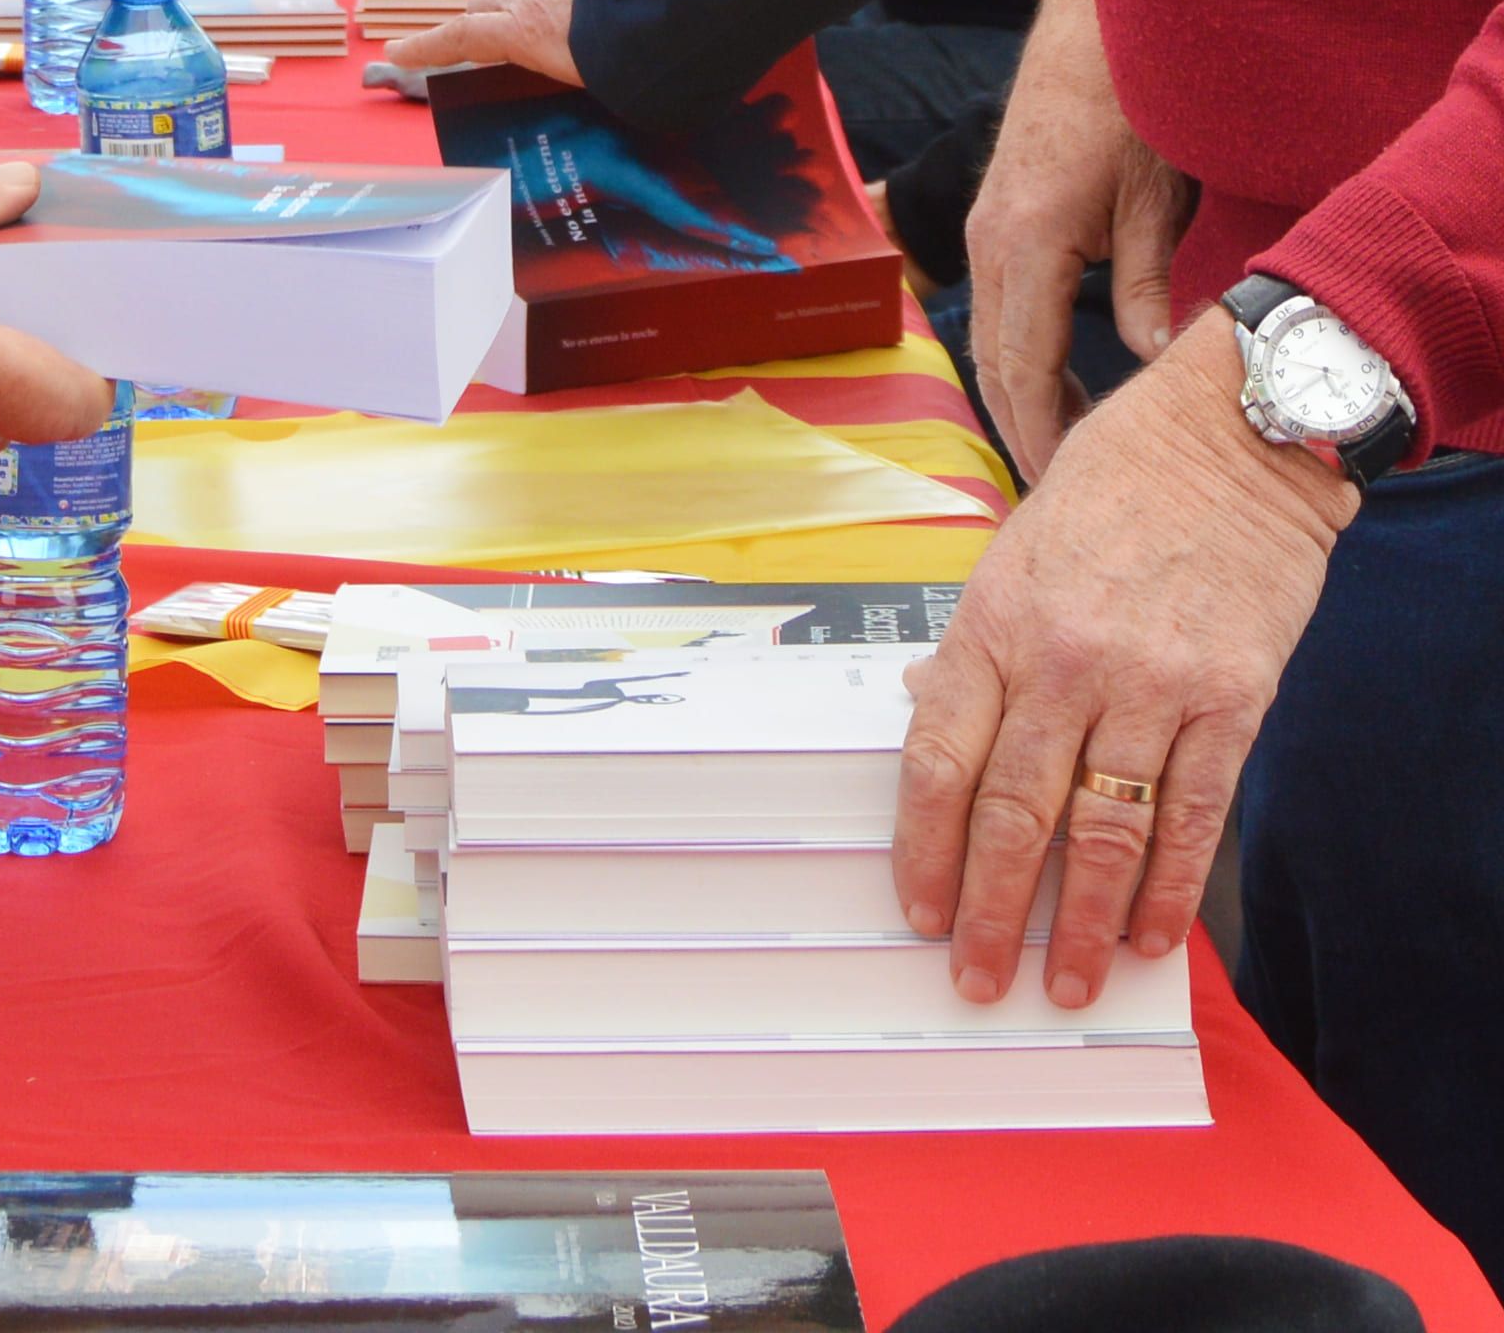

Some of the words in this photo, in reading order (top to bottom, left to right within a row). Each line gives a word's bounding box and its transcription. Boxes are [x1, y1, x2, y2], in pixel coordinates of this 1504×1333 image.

[537, 134, 562, 194] eterna
[562, 150, 589, 204] noche
[556, 198, 572, 216] es
[582, 208, 598, 225] la
[567, 220, 587, 242] No
[1278, 344, 1290, 357] 5
[1275, 367, 1286, 379] 4
[1361, 360, 1377, 375] 10
[1298, 404, 1312, 417] 2
[1344, 400, 1361, 415] 12
[922, 586, 963, 601] La
[851, 603, 911, 643] l'escrip
[631, 1190, 711, 1331] VALLDAURA
